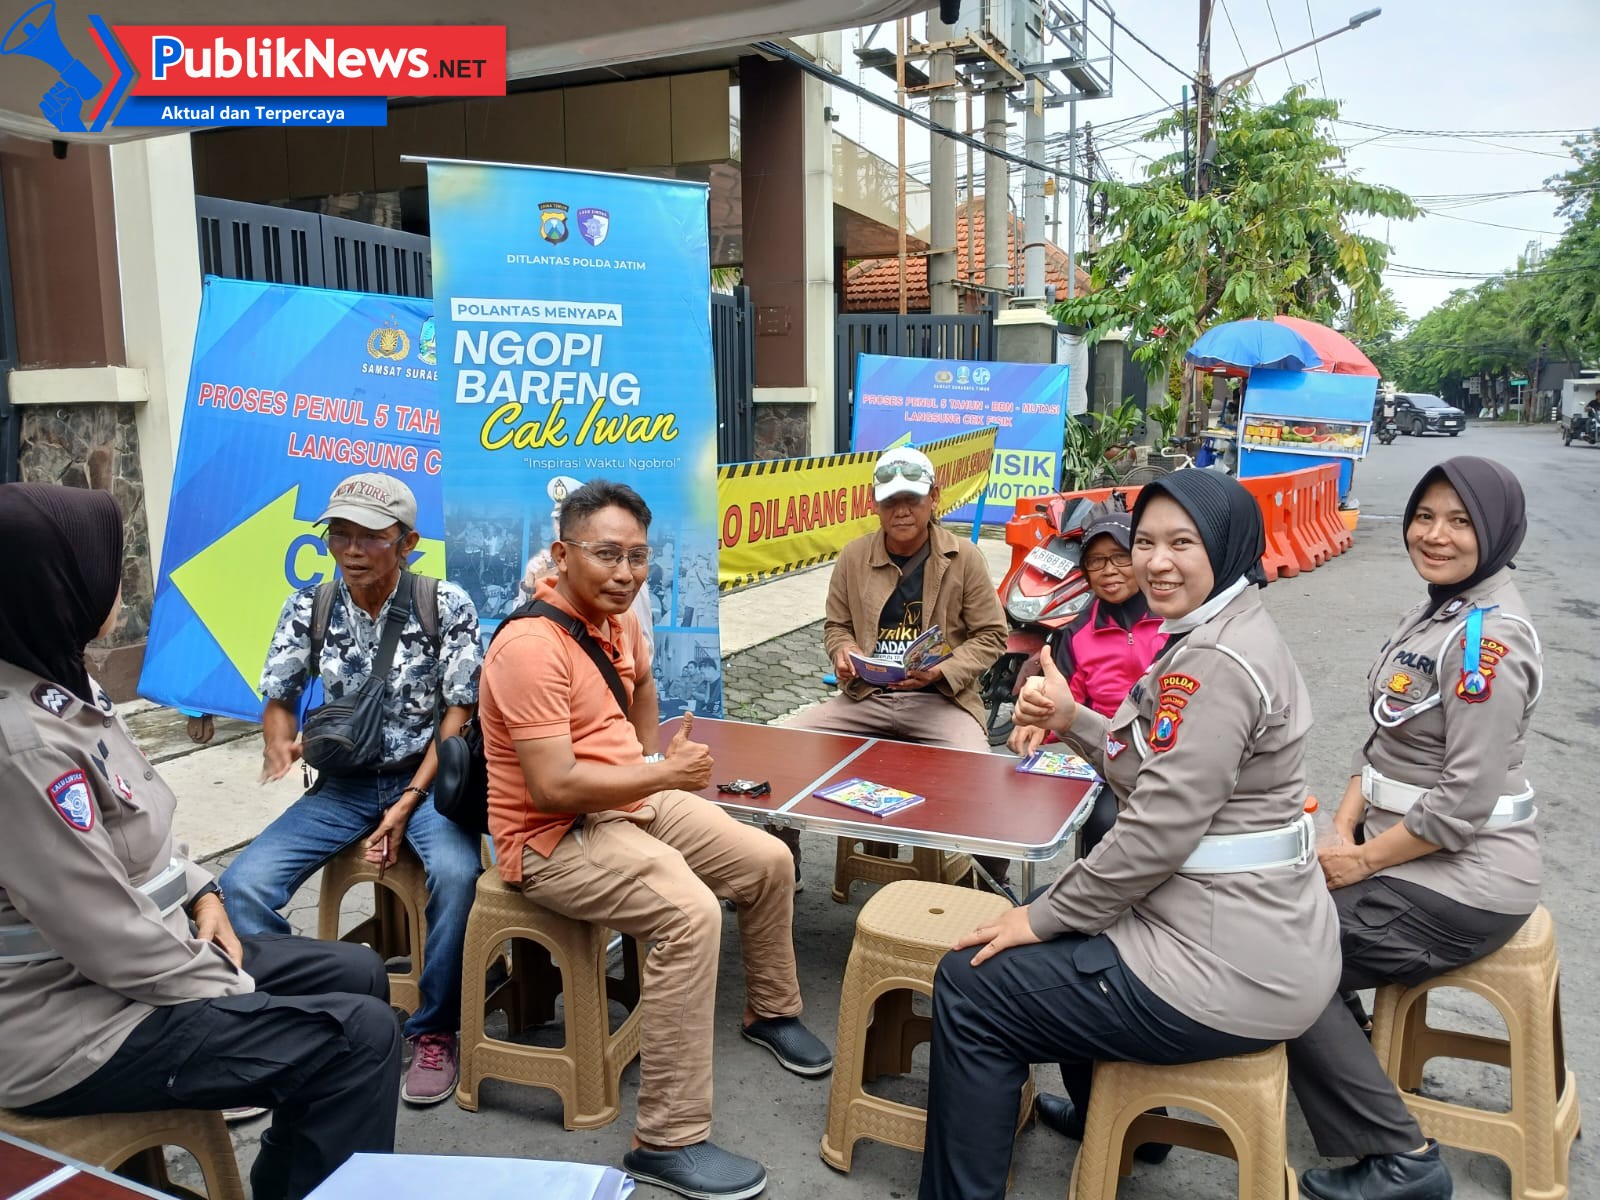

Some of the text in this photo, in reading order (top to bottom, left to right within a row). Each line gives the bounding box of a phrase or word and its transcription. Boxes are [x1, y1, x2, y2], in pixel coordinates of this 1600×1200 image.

[507, 254, 646, 271] DITLANTAS POLDA JATIM
[457, 304, 617, 320] POLANTAS MENYAPA
[453, 329, 603, 367] NGOPI
[362, 363, 402, 376] SAMSAT
[455, 369, 641, 406] BARENG
[198, 383, 440, 436] PROSES PENUL 5 TAH
[904, 410, 960, 425] LANGSUNG
[963, 414, 984, 426] CEK
[950, 399, 983, 411] TAHUN
[1022, 402, 1060, 415] MUTASI
[480, 397, 678, 450] Cak Iwan
[288, 432, 418, 473] LANGSUNG
[584, 458, 625, 469] Waktu
[333, 480, 388, 504] NEW YORK
[748, 487, 848, 544] DILARANG
[1393, 650, 1435, 676] POLRI
[1163, 676, 1194, 690] POLDA
